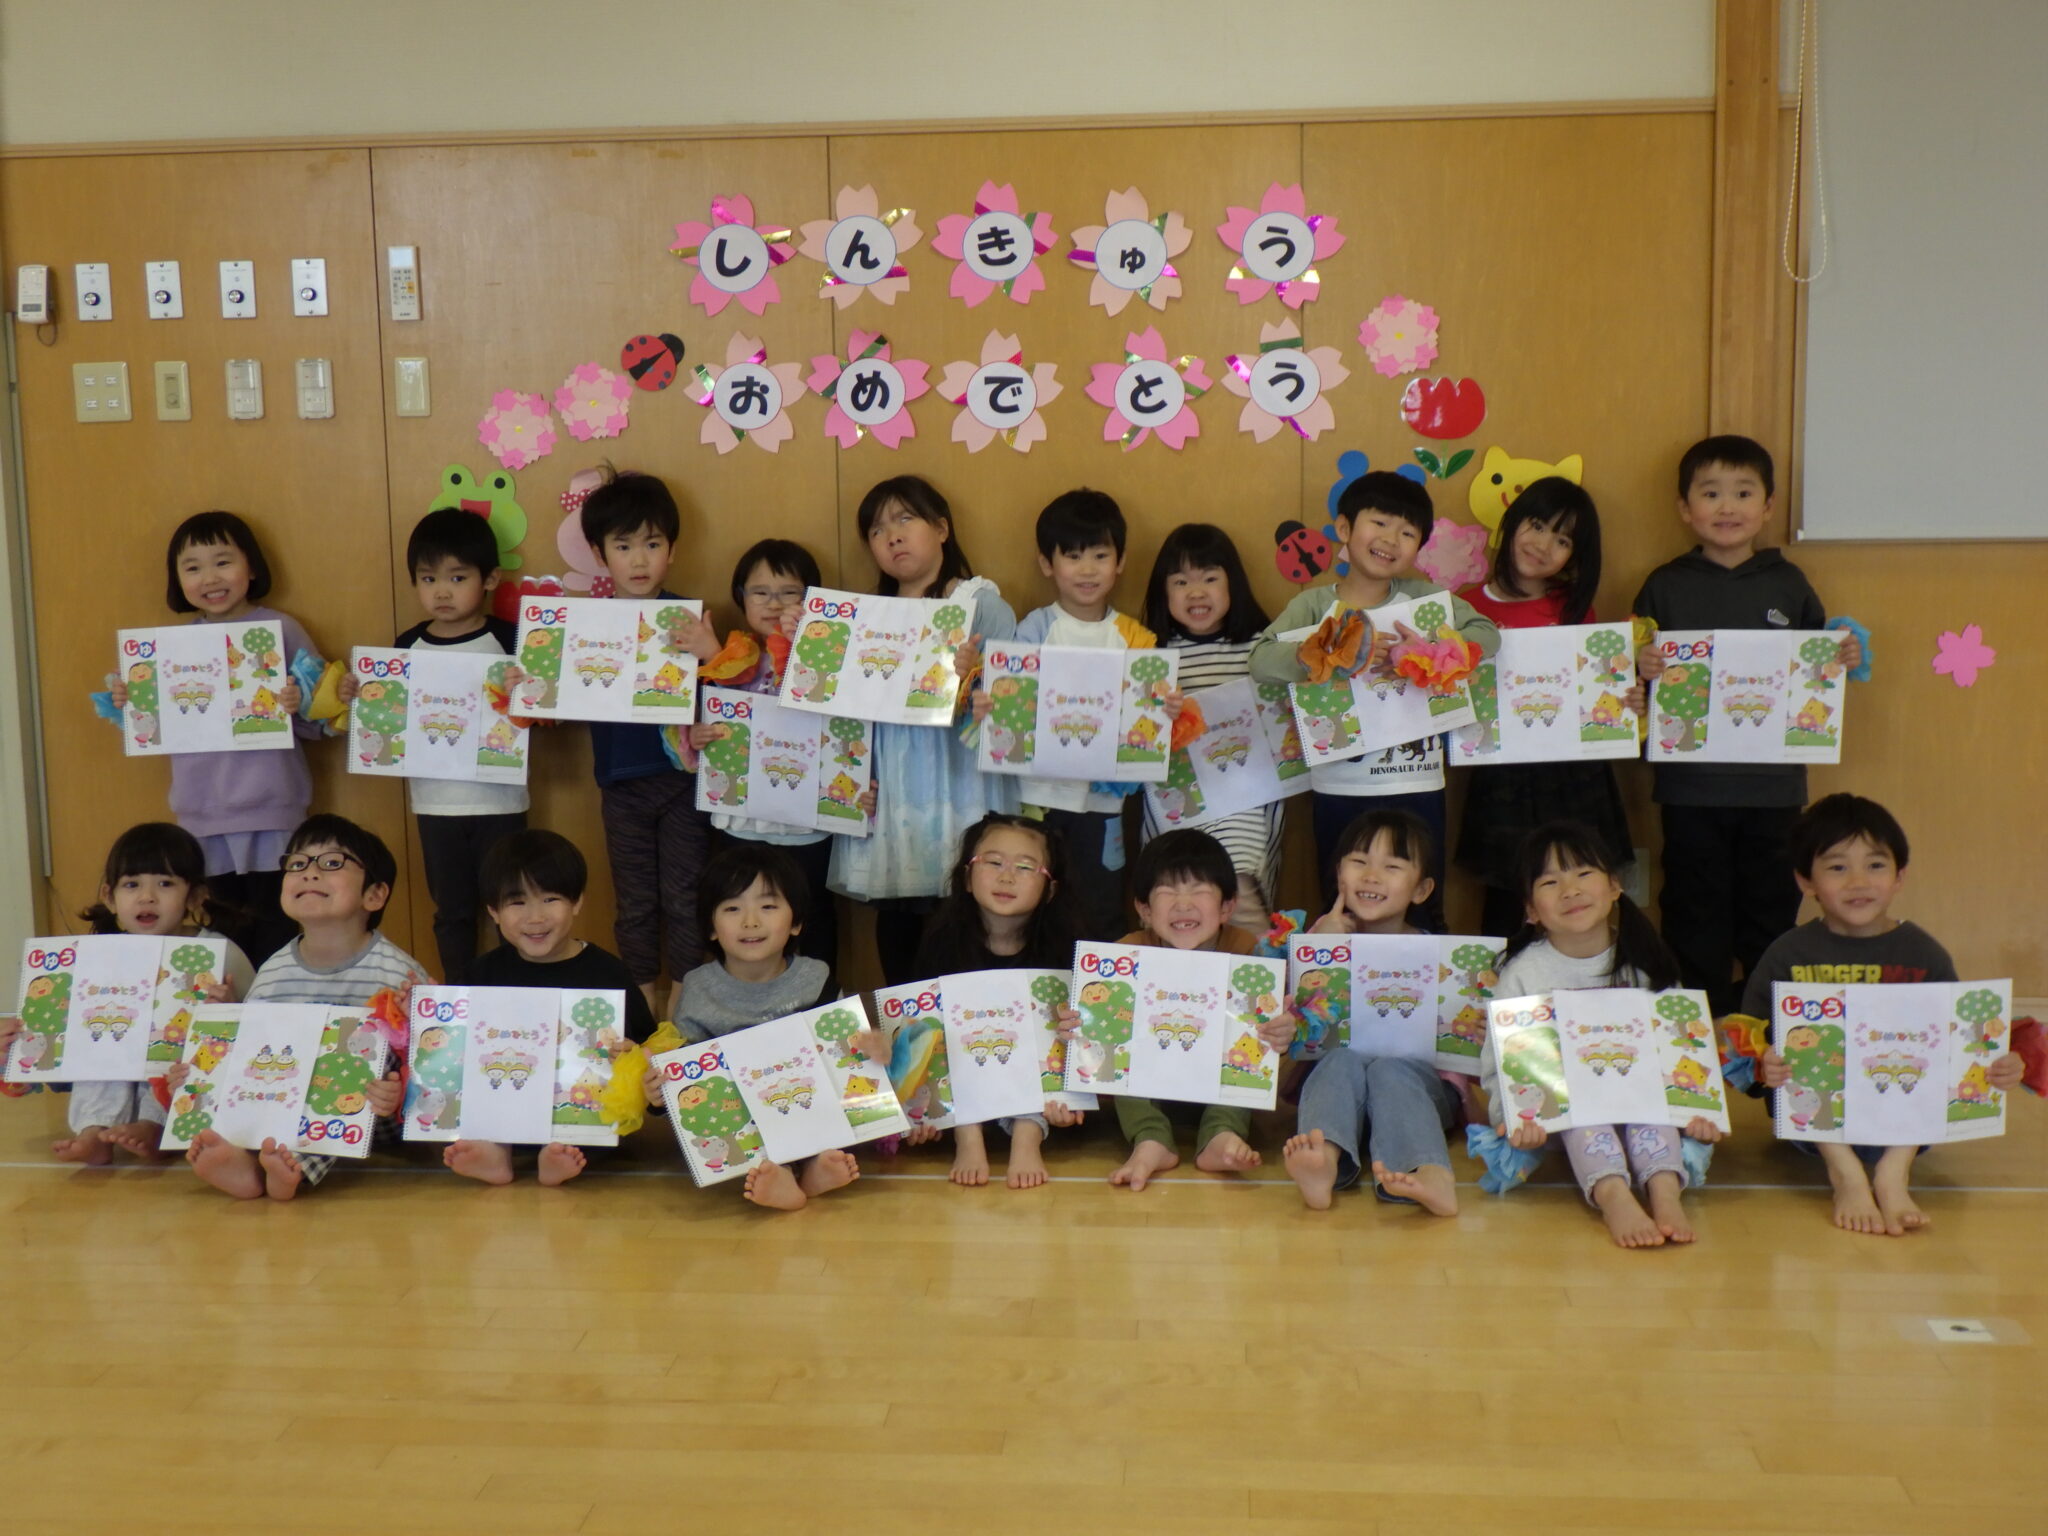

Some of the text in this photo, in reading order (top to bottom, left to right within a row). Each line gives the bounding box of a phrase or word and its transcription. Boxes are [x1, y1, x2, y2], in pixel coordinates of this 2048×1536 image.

[714, 226, 1297, 279] しんきゅう
[730, 360, 1305, 416] おめでとう
[1370, 764, 1415, 775] DINOSAUR
